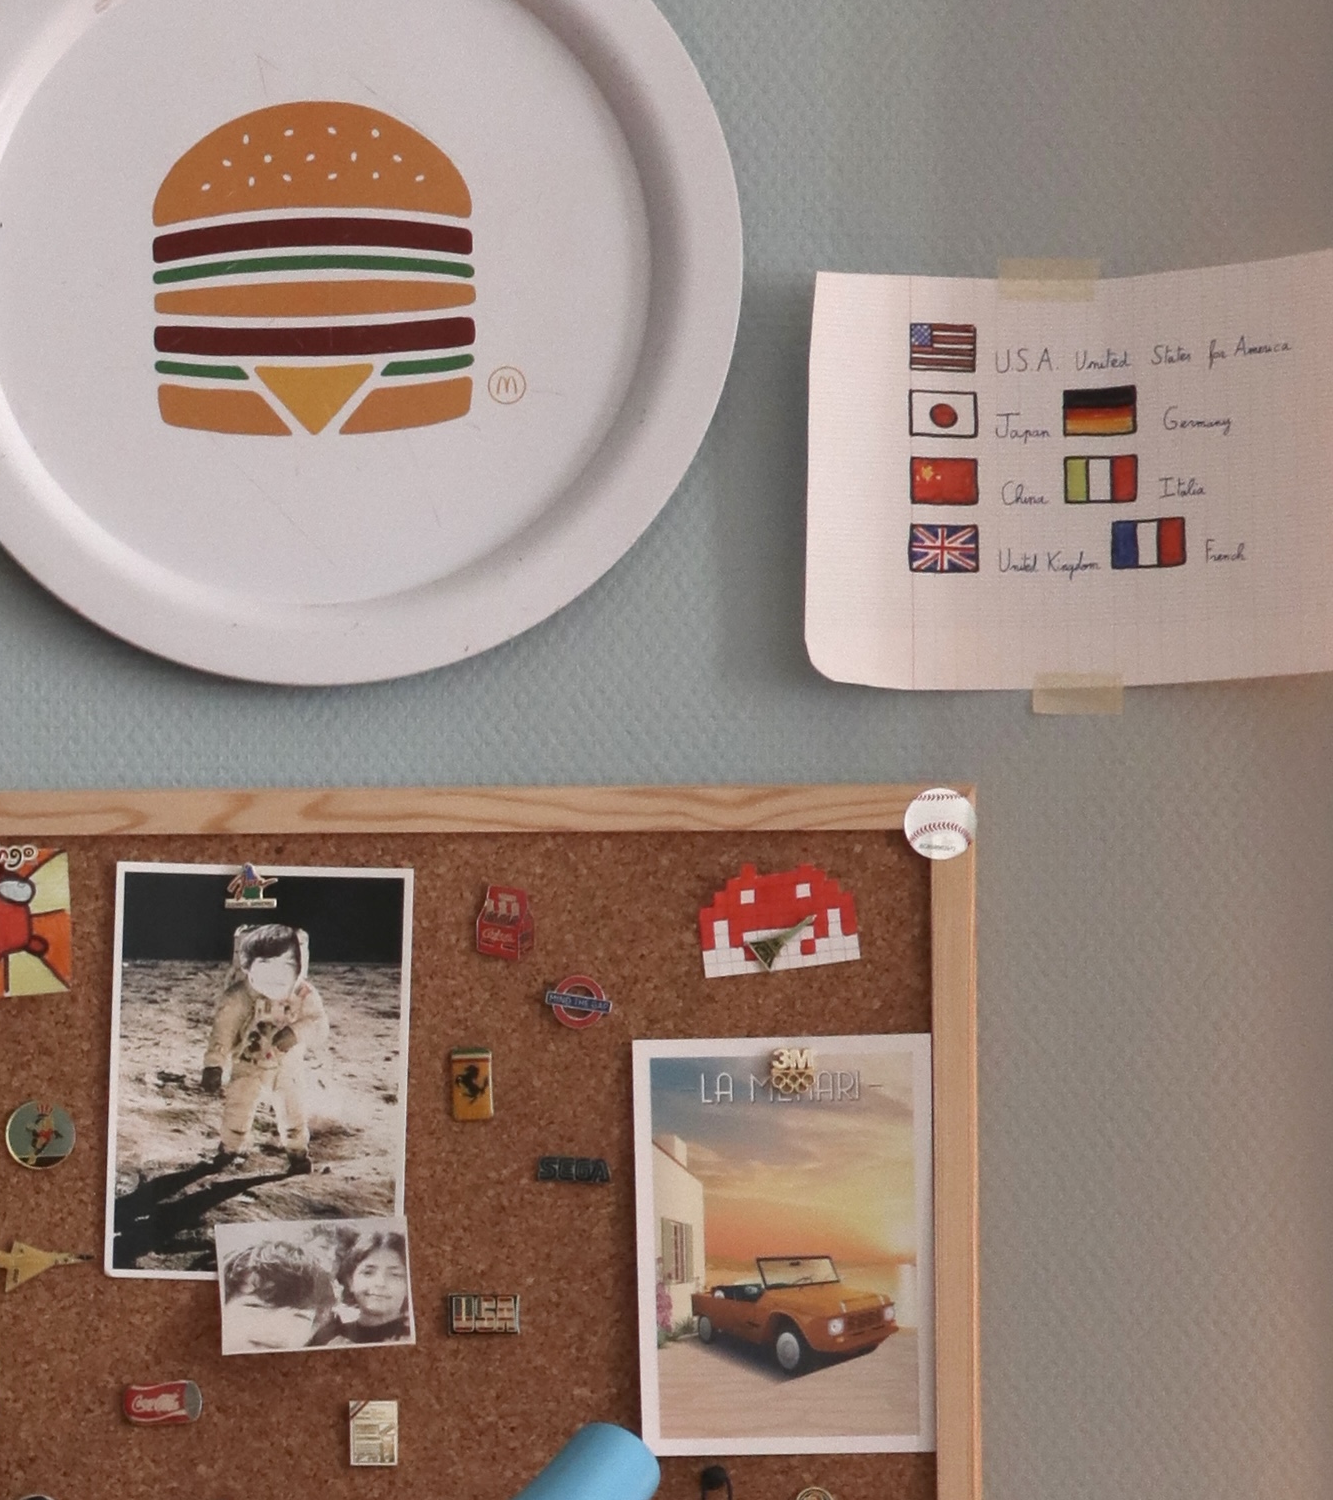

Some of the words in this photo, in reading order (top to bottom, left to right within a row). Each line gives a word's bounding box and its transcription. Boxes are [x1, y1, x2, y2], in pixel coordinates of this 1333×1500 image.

[1075, 349, 1131, 371] United
[996, 412, 1051, 443] Japan
[1163, 405, 1232, 436] Germany
[1159, 477, 1206, 499] Italia
[998, 548, 1039, 574] United
[1046, 551, 1101, 580] Kingdom
[549, 993, 571, 1005] MIND
[574, 997, 588, 1008] THE
[590, 999, 608, 1010] GAP
[772, 1048, 814, 1070] 3M
[701, 1071, 732, 1103] LA
[750, 1069, 860, 1102] MARI
[538, 1157, 611, 1182] SEGA
